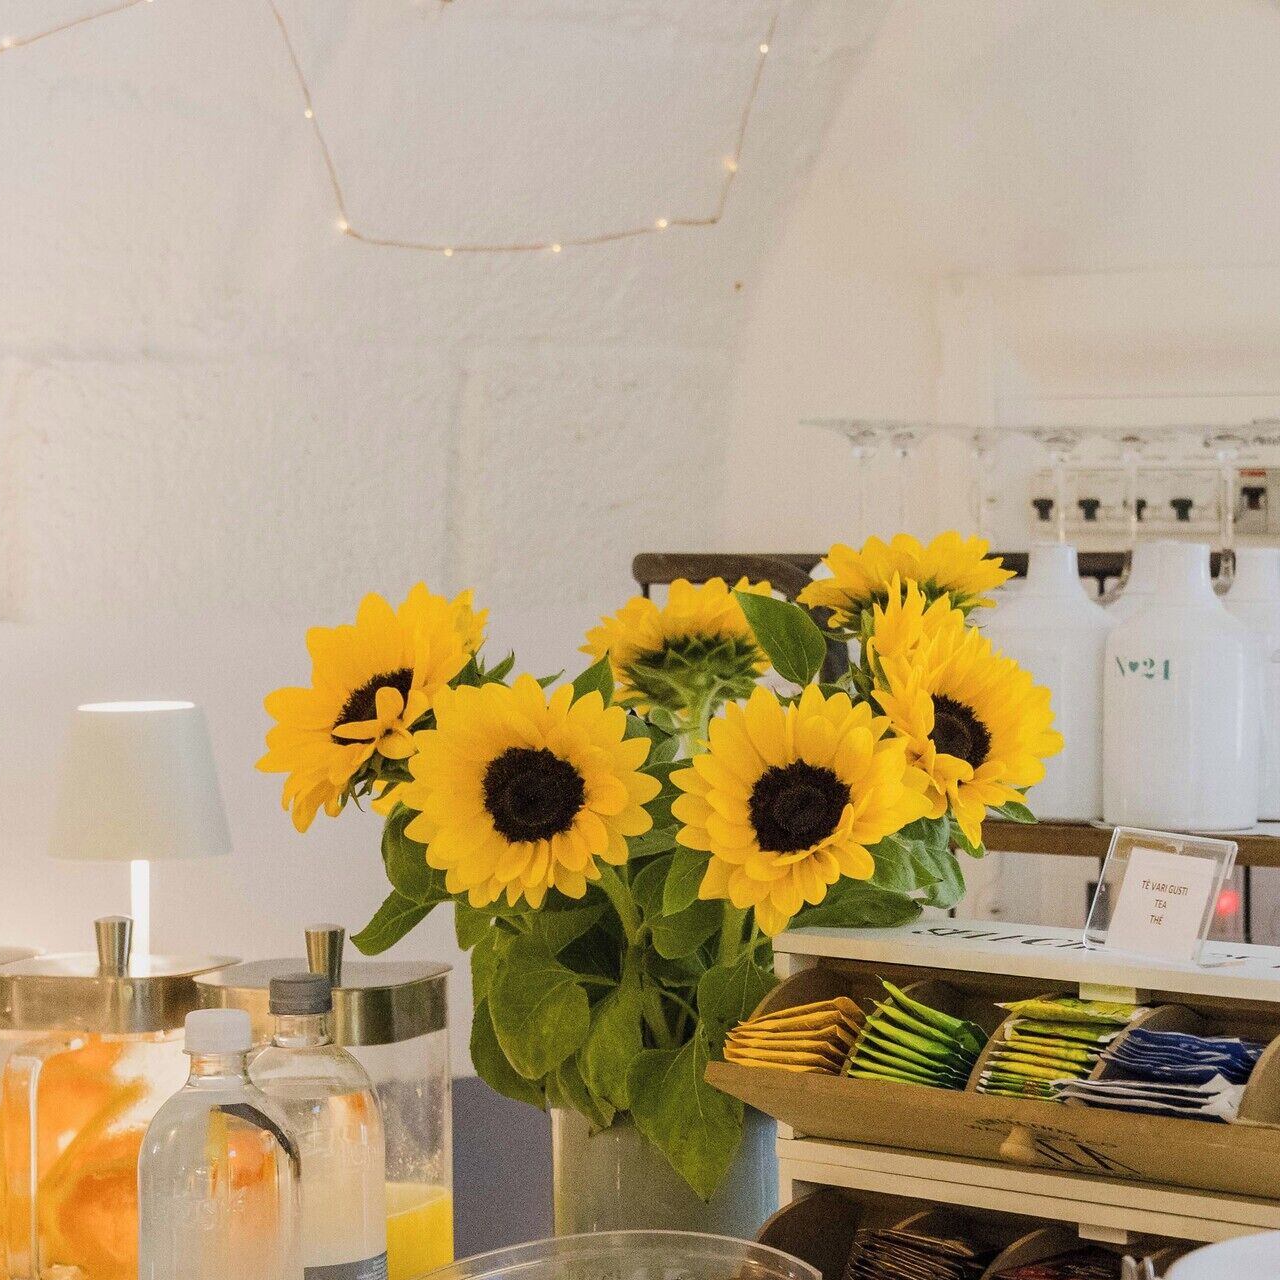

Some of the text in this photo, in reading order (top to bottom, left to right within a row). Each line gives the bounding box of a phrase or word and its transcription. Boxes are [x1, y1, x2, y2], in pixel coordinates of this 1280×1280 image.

[1151, 882, 1168, 892] VARI
[1168, 885, 1189, 895] GUSTI
[1154, 899, 1167, 909] TEA
